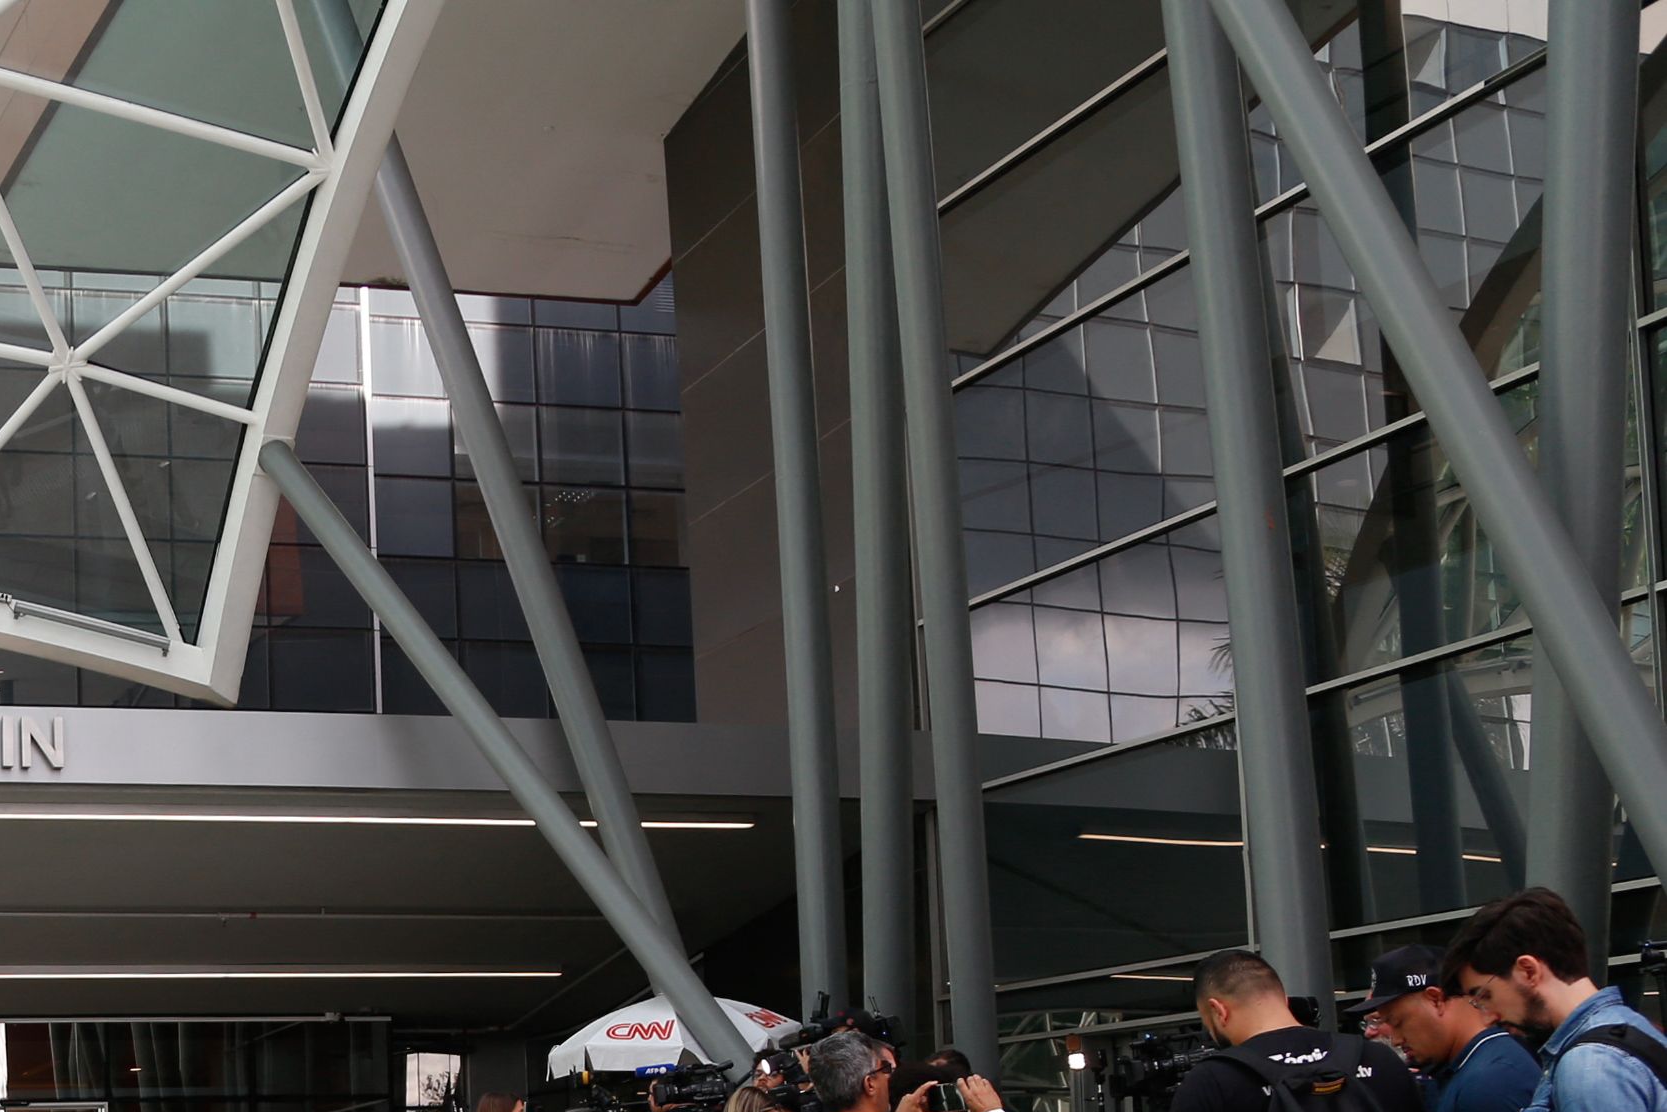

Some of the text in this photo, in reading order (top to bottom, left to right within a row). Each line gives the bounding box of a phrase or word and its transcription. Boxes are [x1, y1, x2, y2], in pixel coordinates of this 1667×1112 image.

[1406, 974, 1427, 987] RDV
[606, 1019, 675, 1040] CNN
[645, 1067, 660, 1075] AFP
